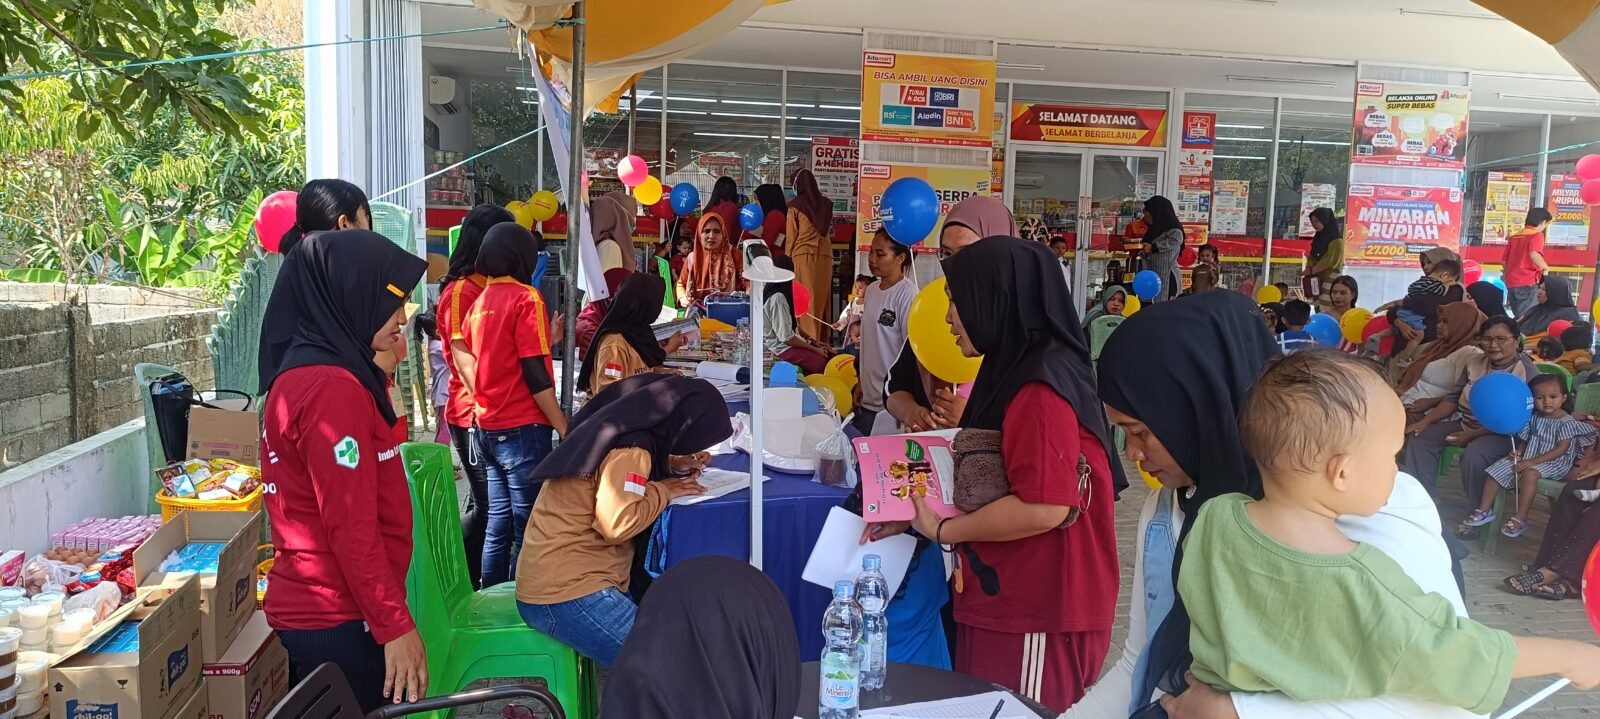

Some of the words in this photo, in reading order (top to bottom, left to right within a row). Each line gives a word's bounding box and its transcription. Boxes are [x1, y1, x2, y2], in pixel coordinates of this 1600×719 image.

[874, 72, 896, 80] BISA
[898, 74, 928, 82] AMBIL
[930, 76, 958, 84] UANG
[960, 77, 988, 86] DISINI
[946, 117, 964, 125] BNI
[1039, 112, 1088, 123] SELAMAT
[1090, 114, 1137, 125] DATANG
[1045, 128, 1083, 138] SELAMAT
[1085, 130, 1137, 140] BERBELANJA
[816, 147, 859, 159] GRATIS
[1552, 189, 1580, 197] MILYAR
[1358, 208, 1450, 225] MILYARAN
[1368, 223, 1439, 240] RUPIAH
[1366, 245, 1404, 255] 27.000
